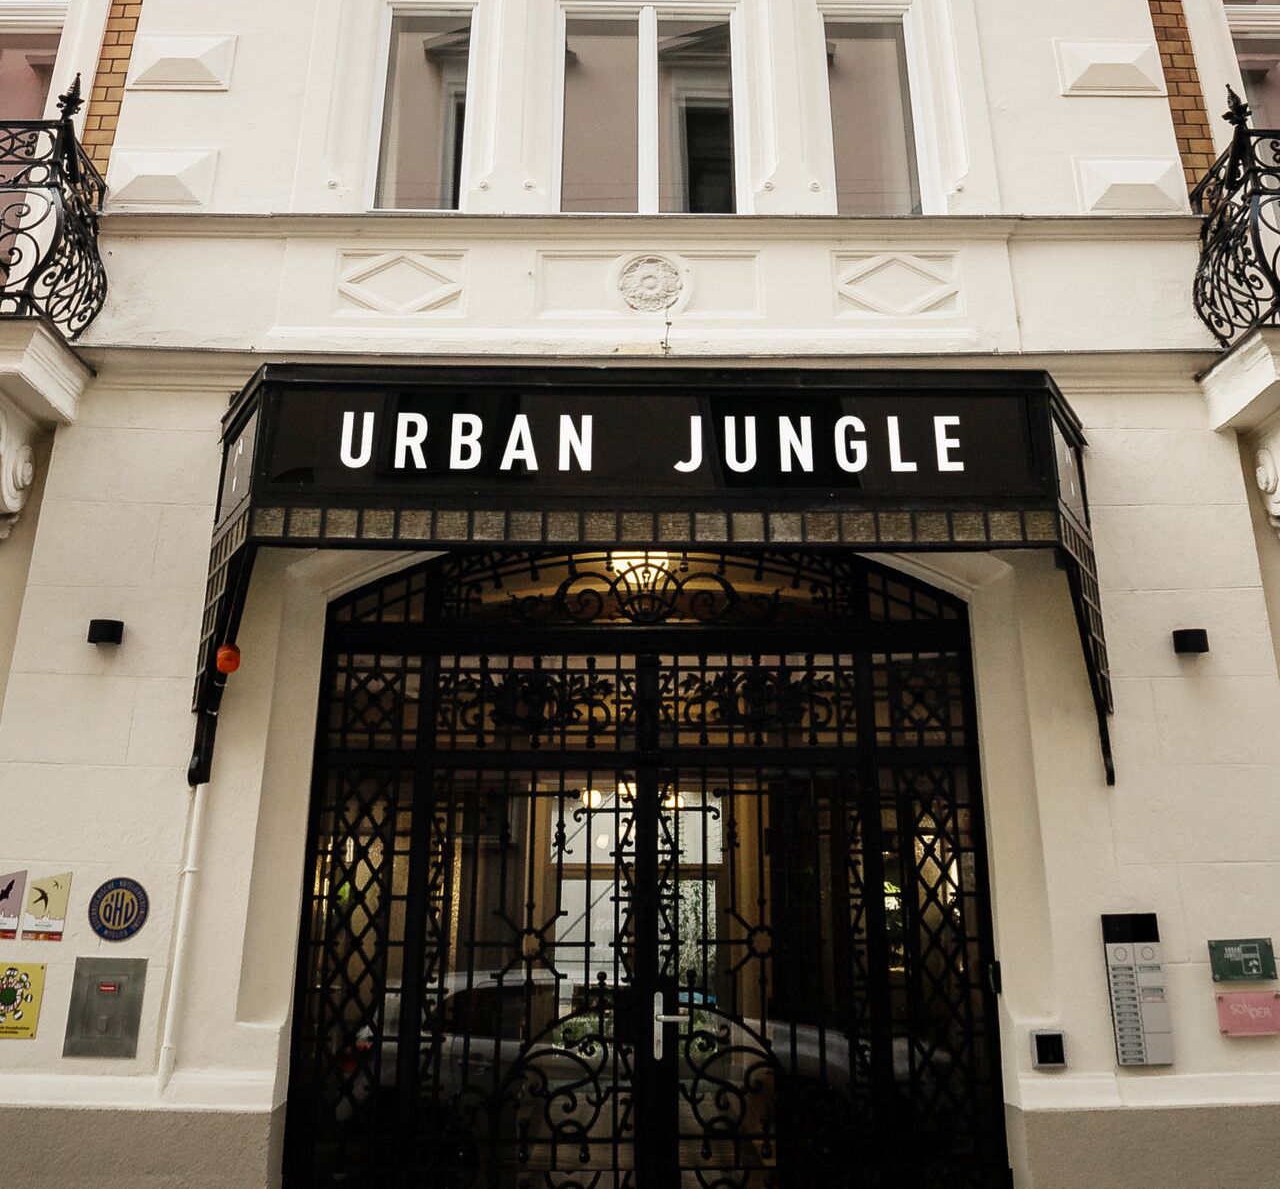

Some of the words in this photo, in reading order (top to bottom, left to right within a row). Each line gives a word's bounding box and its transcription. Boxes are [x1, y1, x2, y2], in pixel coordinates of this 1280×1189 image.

[340, 411, 593, 471] URBAN
[673, 415, 965, 473] JUNGLE
[1230, 1001, 1273, 1018] SONDER
